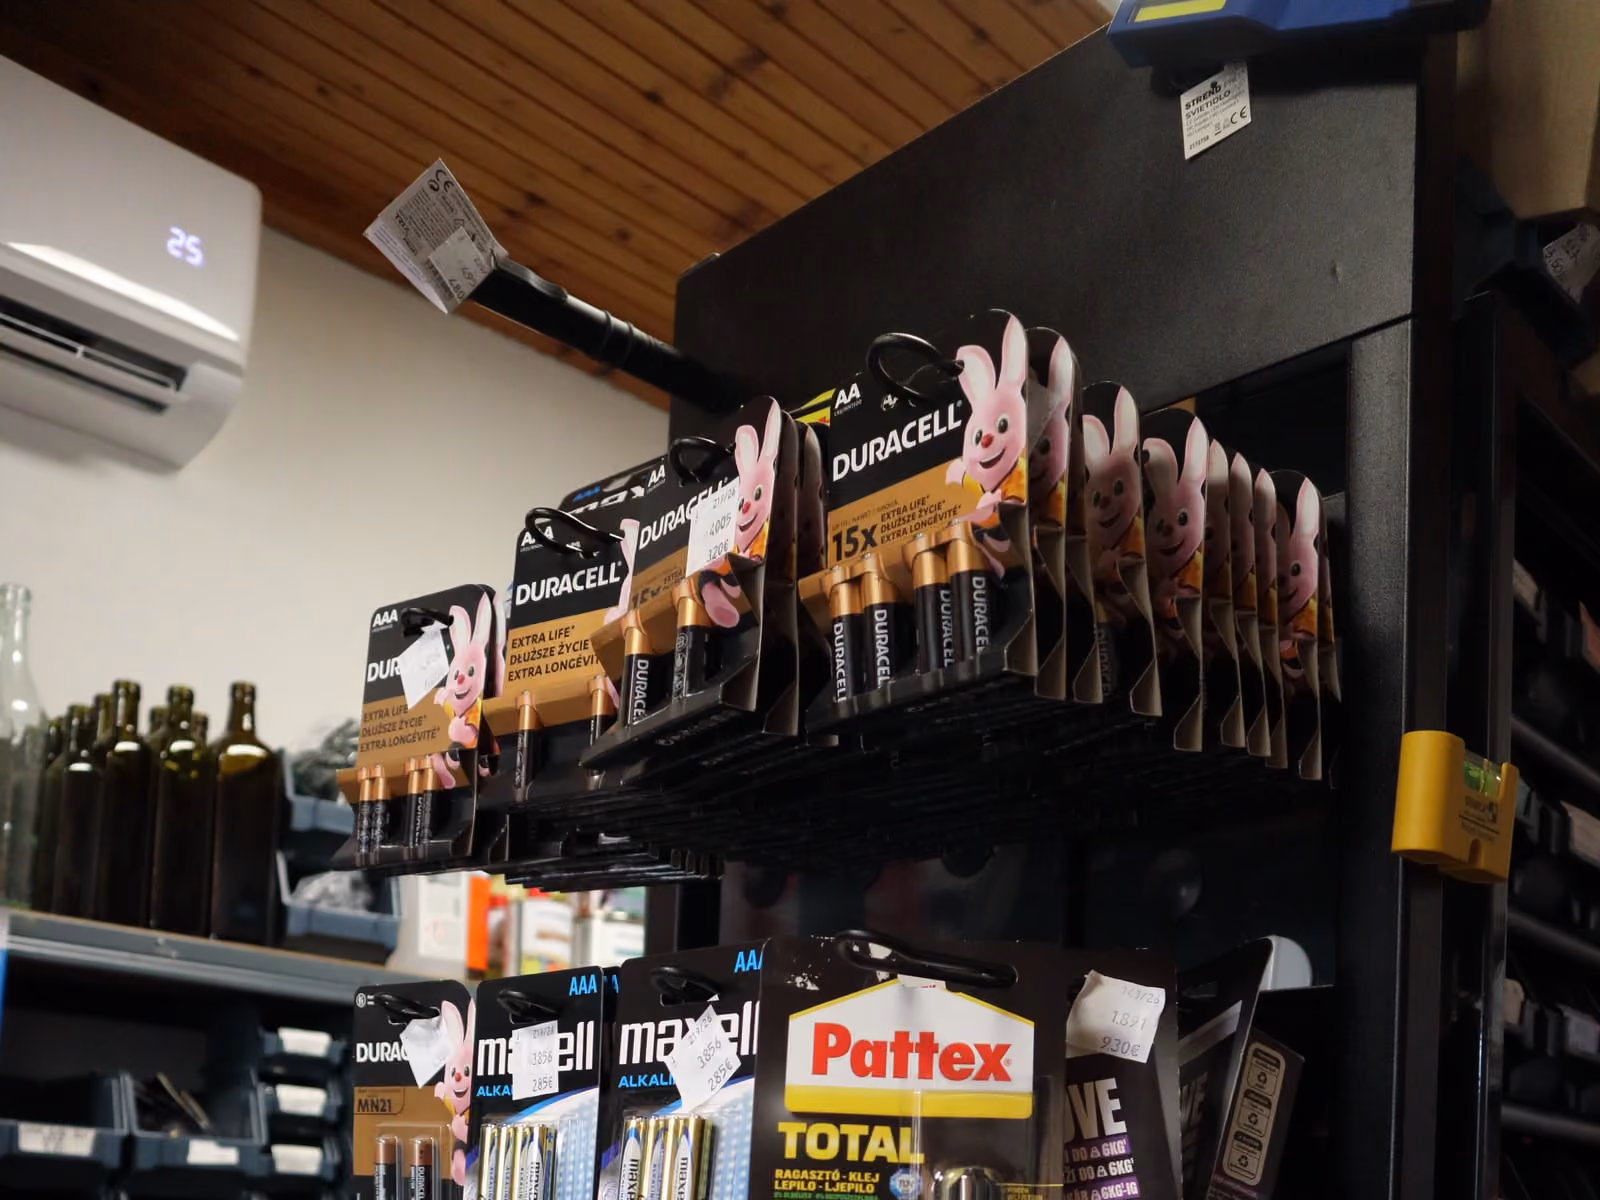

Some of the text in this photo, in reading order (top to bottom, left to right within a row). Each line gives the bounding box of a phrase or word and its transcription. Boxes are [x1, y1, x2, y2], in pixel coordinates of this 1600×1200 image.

[167, 226, 204, 266] 25
[834, 383, 862, 409] AA
[832, 402, 963, 482] DURACELL
[881, 507, 908, 522] EXTRA
[832, 524, 878, 562] 15x
[881, 529, 908, 544] EXTRA
[515, 562, 621, 606] DURACELL
[372, 609, 398, 628] AAA
[511, 634, 546, 649] EXTRA
[508, 665, 542, 681] EXTRA
[363, 709, 389, 722] EXTRA
[360, 738, 387, 752] EXTRA
[569, 974, 598, 996] AAA
[477, 1020, 595, 1077] mell
[811, 1022, 1012, 1082] Pattex
[357, 1098, 392, 1113] MN21
[777, 1122, 925, 1164] TOTAL
[774, 1168, 880, 1183] RAGASZTÓ KLEJ
[774, 1180, 874, 1194] LEPILO LJEPILO
